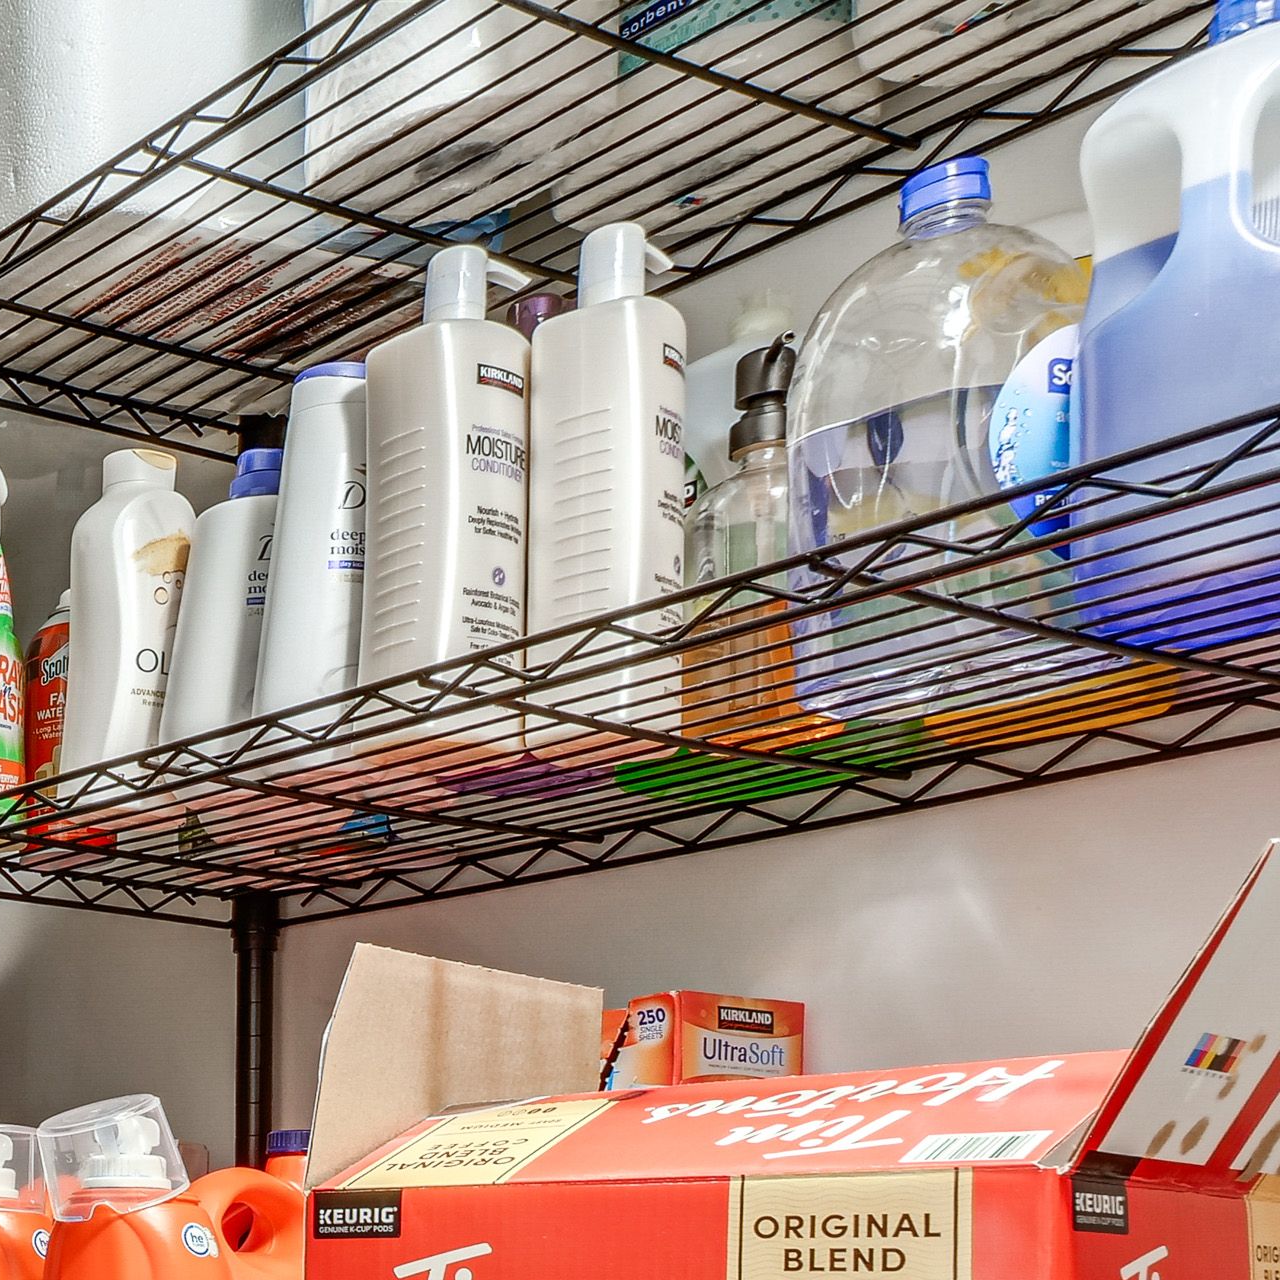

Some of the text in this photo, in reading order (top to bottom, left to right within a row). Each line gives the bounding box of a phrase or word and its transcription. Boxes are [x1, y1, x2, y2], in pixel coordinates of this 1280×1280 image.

[480, 366, 523, 389] KIRKLAND
[466, 434, 526, 471] MOISTURE
[472, 458, 522, 483] CONDITIONER
[330, 544, 366, 555] mois
[135, 648, 168, 675] OL
[637, 1008, 666, 1026] 250
[720, 1008, 773, 1025] KIRKLAND
[638, 1032, 663, 1041] SHEETS
[639, 1024, 663, 1033] SINGLE
[715, 1109, 902, 1160] Tim
[432, 1138, 529, 1150] COFFEE
[419, 1147, 507, 1160] BLEND
[385, 1156, 517, 1171] ORIGINAL
[1075, 1192, 1125, 1215] KEURIG
[319, 1207, 396, 1225] KEURIG
[753, 1213, 942, 1240] ORIGINAL
[190, 1232, 204, 1244] he
[783, 1247, 906, 1273] BLEND
